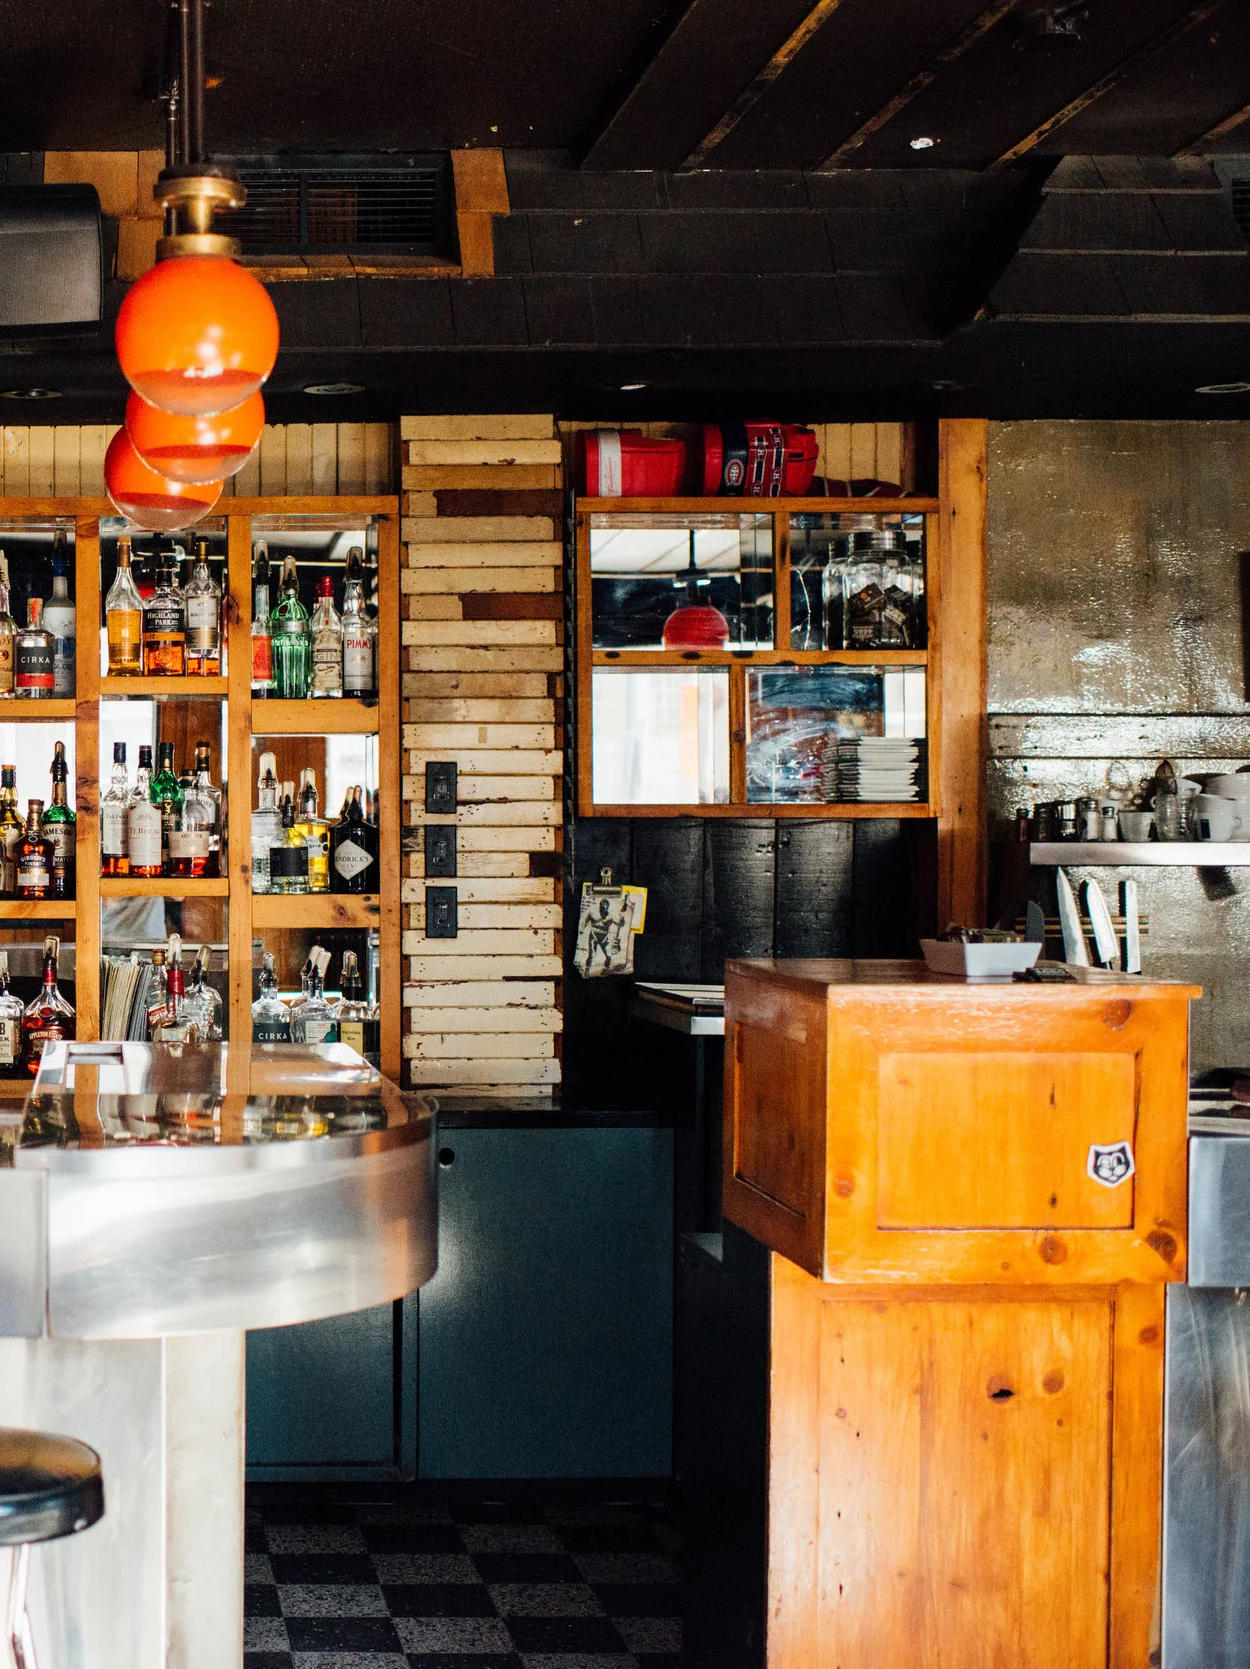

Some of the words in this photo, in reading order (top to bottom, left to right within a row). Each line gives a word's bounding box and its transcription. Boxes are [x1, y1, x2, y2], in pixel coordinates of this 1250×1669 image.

[147, 612, 180, 620] HIGHLAND
[346, 639, 372, 649] PIMM'S
[20, 656, 51, 664] CIRKA
[258, 1032, 288, 1040] CIRKA
